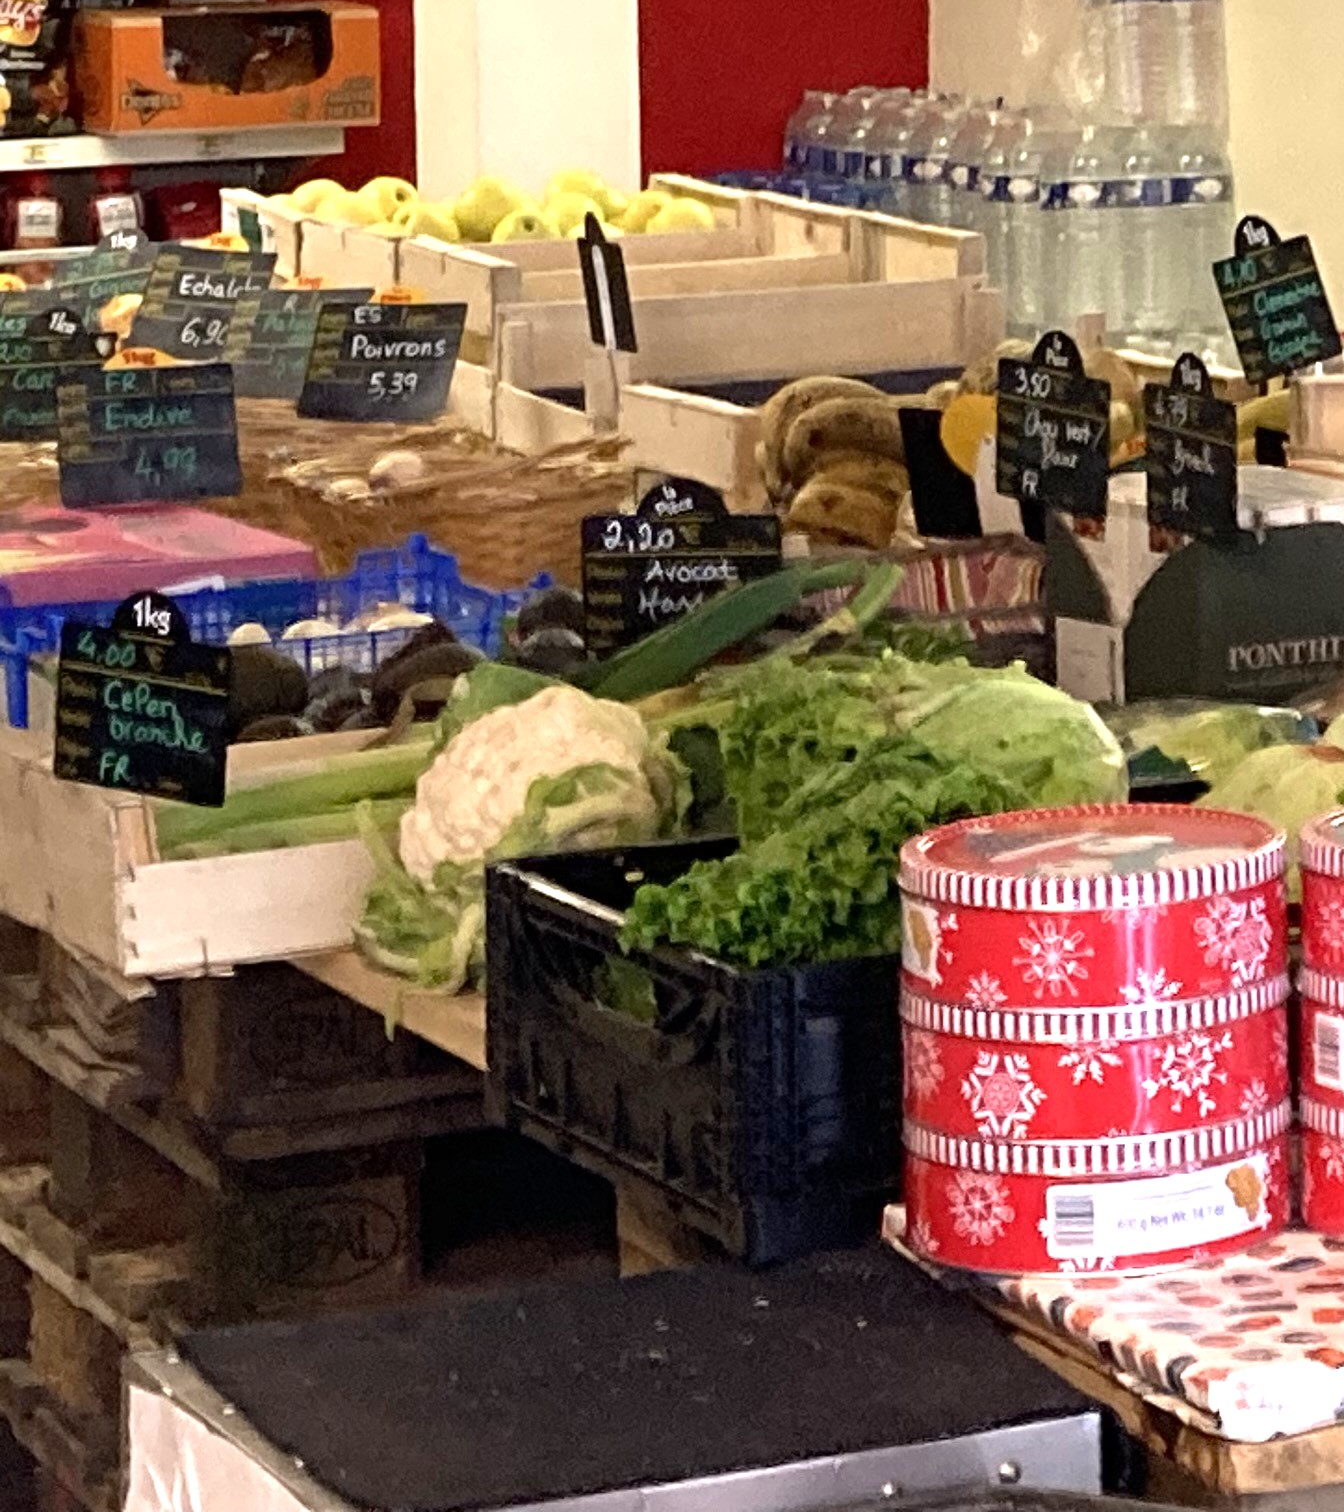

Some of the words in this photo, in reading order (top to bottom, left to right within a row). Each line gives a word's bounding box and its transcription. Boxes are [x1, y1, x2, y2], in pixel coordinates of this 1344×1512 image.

[353, 305, 382, 325] ES
[351, 333, 447, 360] Poivrons
[104, 373, 137, 393] FR
[368, 370, 419, 402] 5,39
[104, 402, 195, 432] Endive
[645, 559, 739, 583] Avocat
[133, 596, 172, 635] 1kg
[77, 631, 137, 667] 4,00
[100, 751, 131, 783] FR
